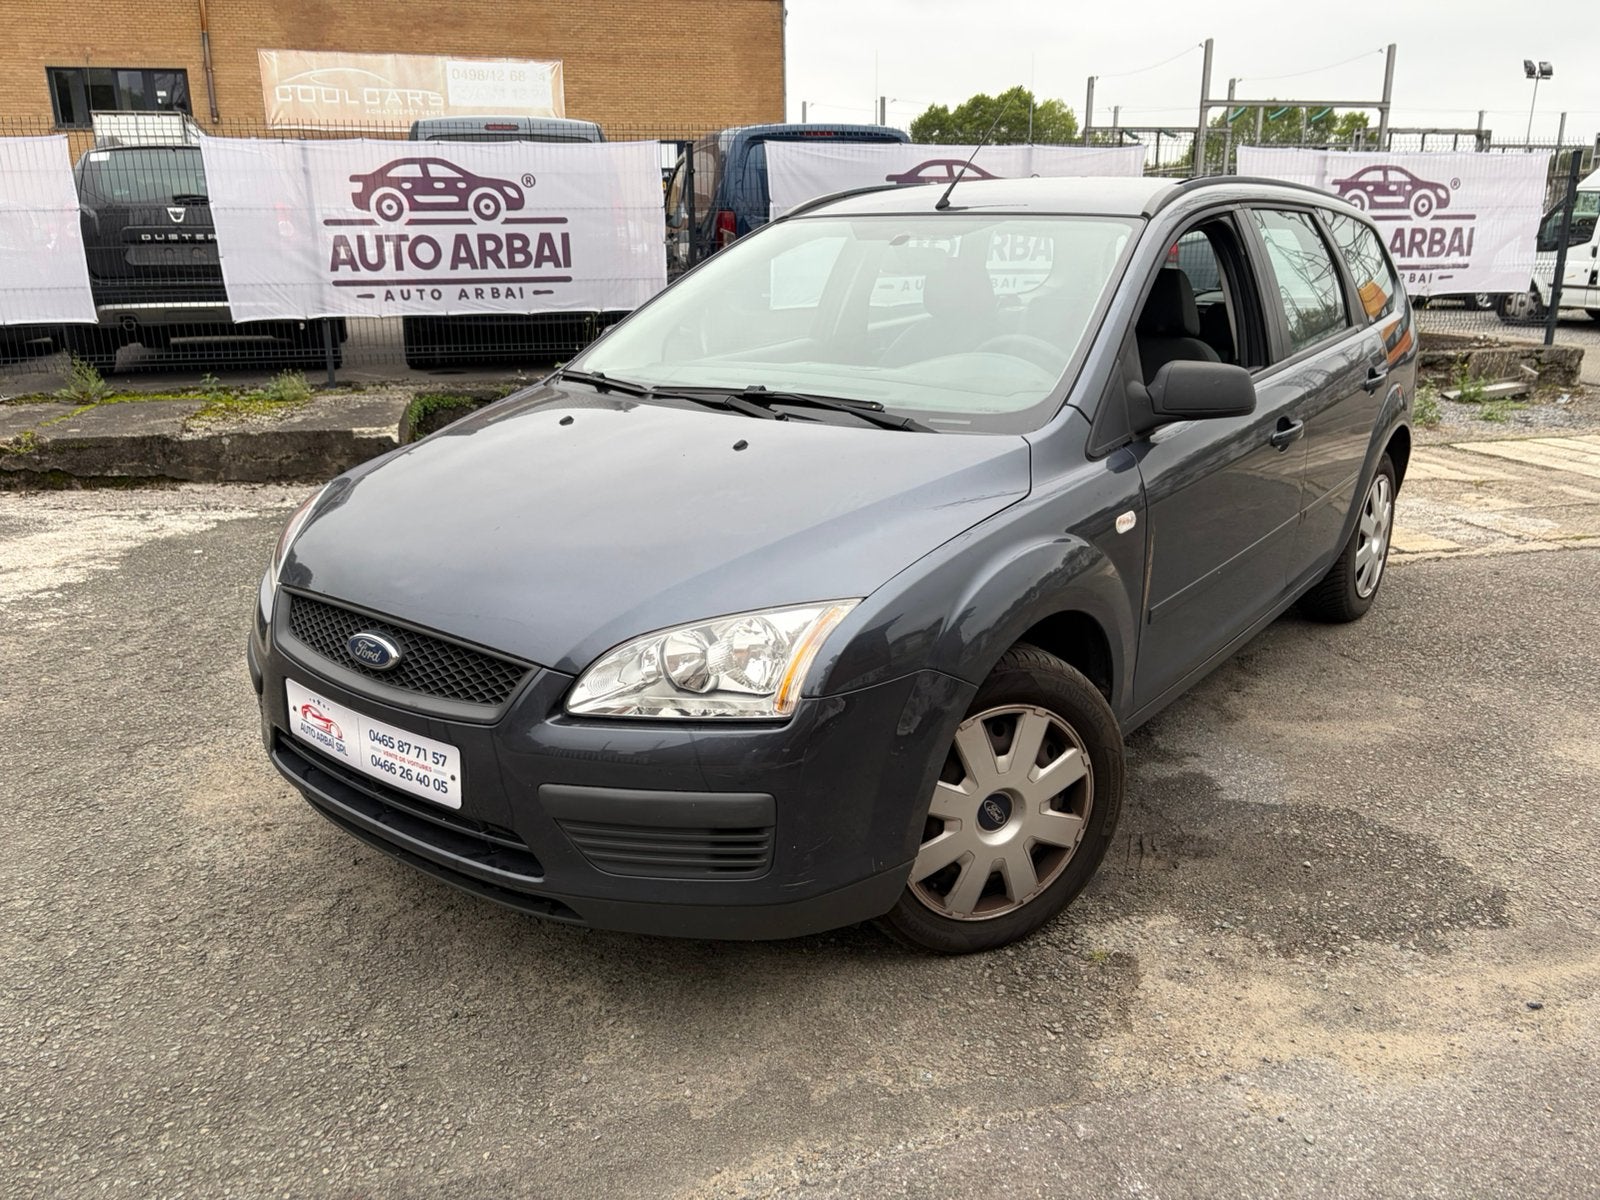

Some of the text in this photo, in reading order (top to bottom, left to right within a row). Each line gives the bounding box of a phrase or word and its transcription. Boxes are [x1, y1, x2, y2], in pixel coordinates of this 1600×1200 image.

[141, 233, 217, 241] DUSTER
[1390, 227, 1475, 258] ARBAI
[330, 232, 572, 272] AUTO ARBAI
[384, 287, 524, 302] AUTO ARBAI
[355, 639, 382, 663] Ford
[300, 722, 316, 738] AUTO
[369, 729, 447, 767] 0465 87 71 57
[383, 750, 398, 761] VENTE
[398, 755, 406, 763] DE
[371, 754, 448, 794] 0466 26 40 05
